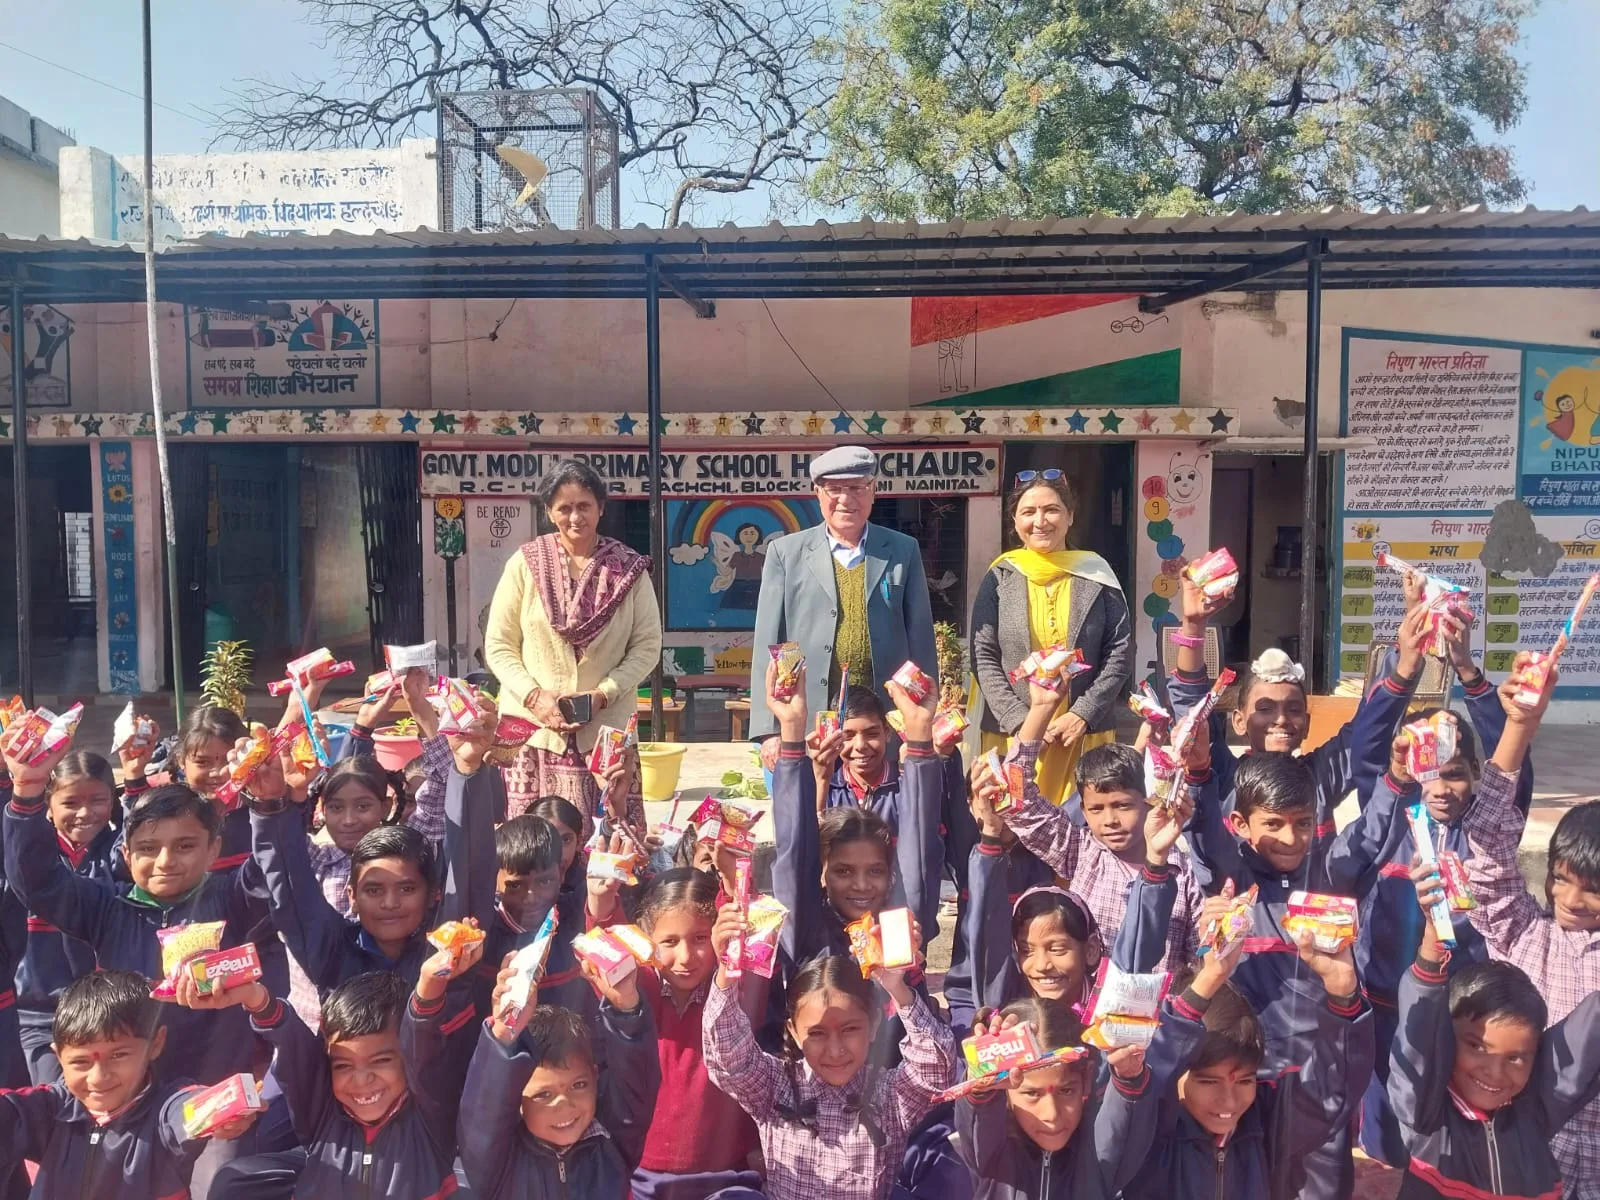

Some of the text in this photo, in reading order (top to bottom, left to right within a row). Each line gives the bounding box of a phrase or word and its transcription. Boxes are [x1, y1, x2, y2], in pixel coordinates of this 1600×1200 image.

[1386, 351, 1416, 373] निपुण
[1450, 351, 1489, 370] प्रतिज्ञा
[203, 376, 242, 397] समग्र
[423, 453, 484, 477] GOVT.
[697, 454, 781, 479] SCHOOL
[493, 505, 521, 518] READY
[1152, 501, 1160, 515] 9
[1431, 519, 1464, 538] निपुण
[1429, 545, 1460, 557] भाषा
[1160, 580, 1168, 592] 5
[206, 954, 254, 980] maaza
[977, 1039, 1026, 1064] maaza
